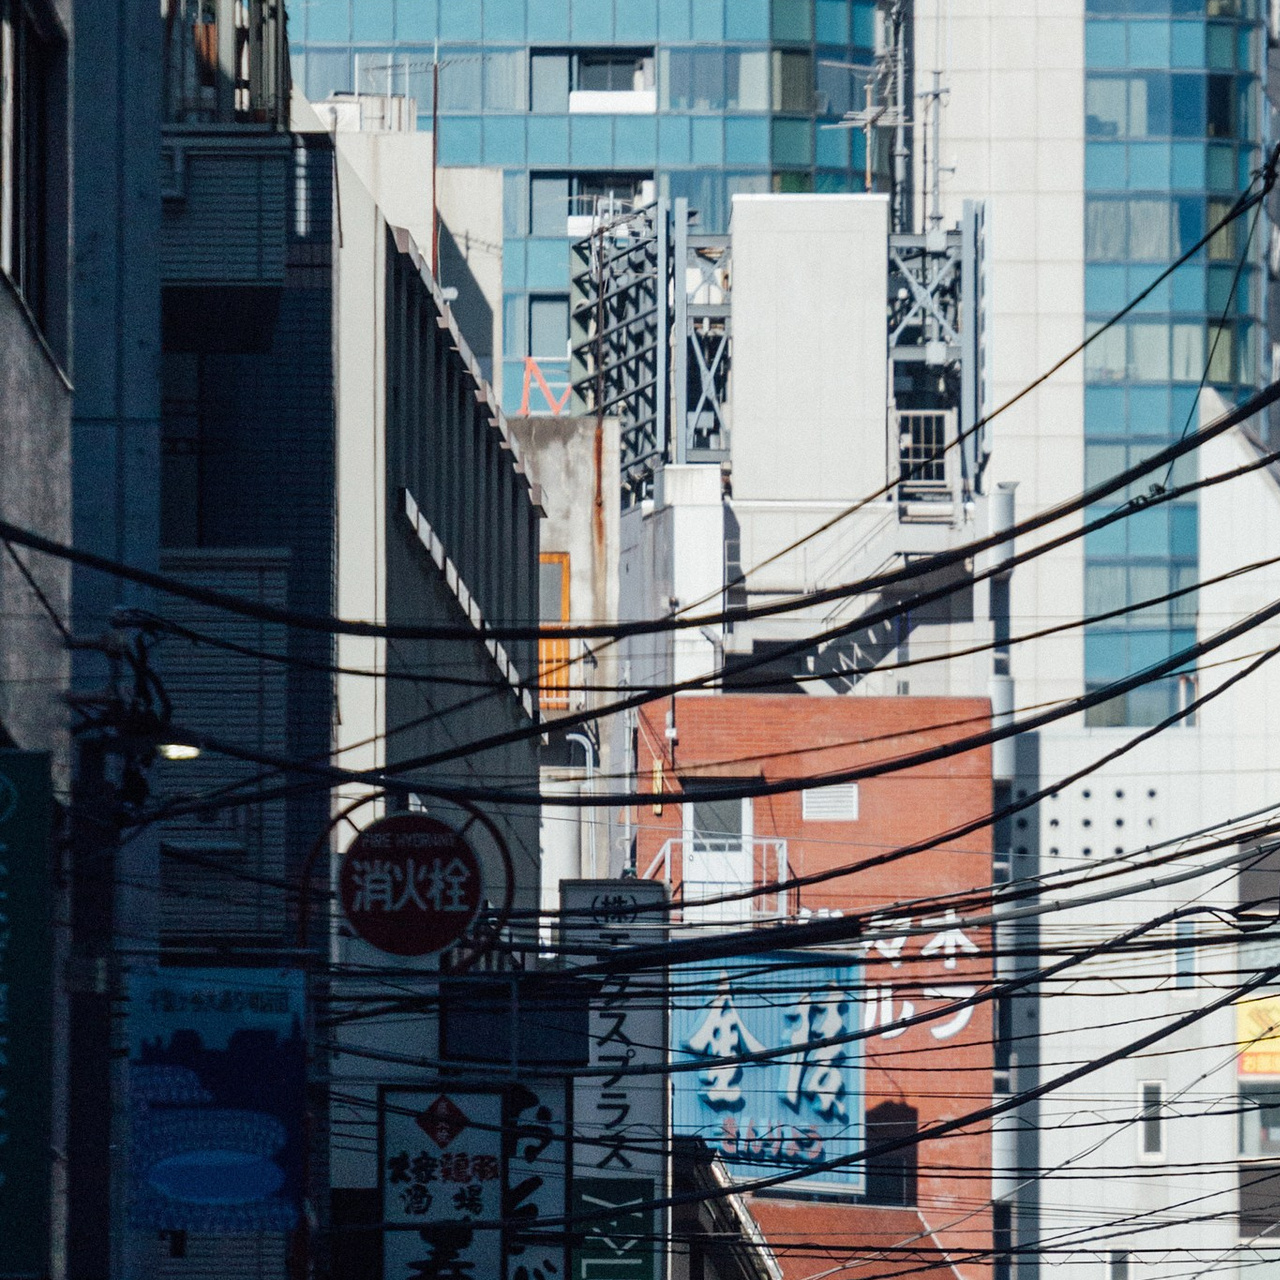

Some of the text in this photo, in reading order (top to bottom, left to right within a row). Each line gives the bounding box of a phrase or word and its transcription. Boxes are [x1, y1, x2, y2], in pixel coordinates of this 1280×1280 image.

[361, 832, 392, 848] FIRE
[351, 857, 471, 913] 消火栓
